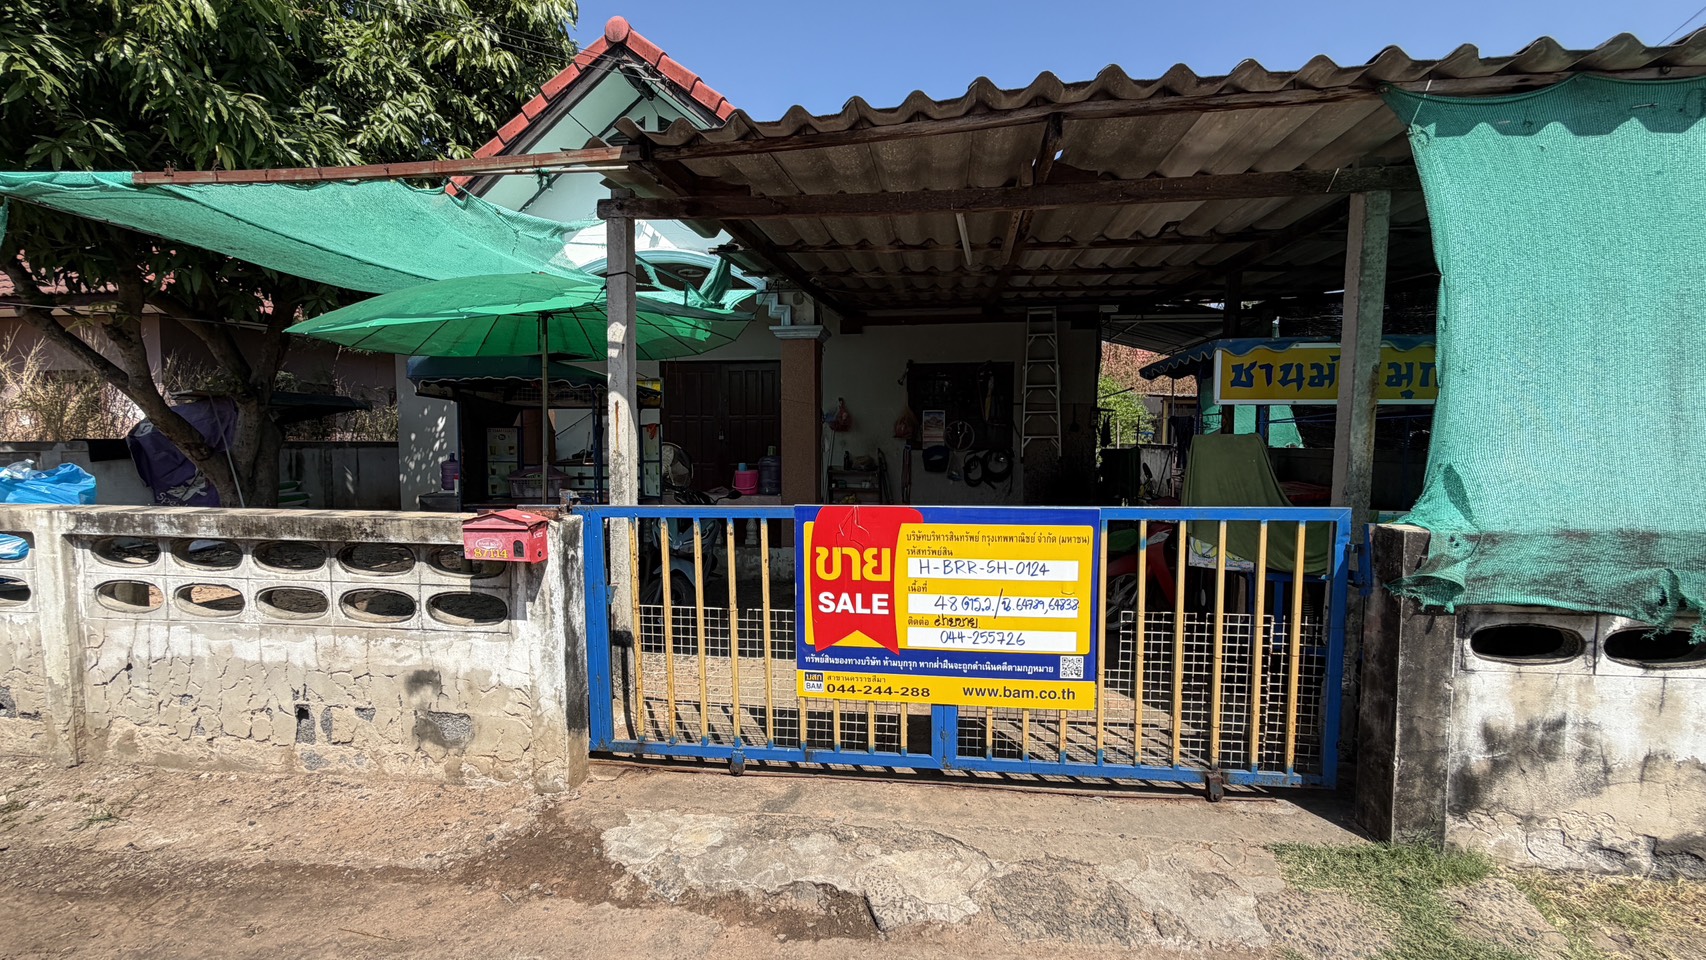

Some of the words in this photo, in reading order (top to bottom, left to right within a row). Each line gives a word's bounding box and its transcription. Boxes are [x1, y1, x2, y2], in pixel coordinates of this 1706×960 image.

[906, 531, 980, 543] บริษัทบริหารสินทรัพย์
[982, 532, 1036, 546] กรุงเทพพาณิชย์
[1038, 534, 1057, 544] จำกัด
[1058, 536, 1090, 545] (มหาชน)
[906, 545, 953, 556] รหัสทรัพย์สิน
[815, 546, 891, 582] ขาย
[919, 558, 1050, 577] H-BRR-SH-0124
[907, 580, 928, 593] เนื้อที่
[817, 591, 890, 615] SALE
[908, 616, 930, 626] ติดต่อ
[940, 630, 1026, 646] 044-255726
[804, 653, 882, 667] ทรัพย์สินของทางบริษัท
[882, 656, 918, 671] ห้ามบุกรุก
[806, 682, 823, 690] BAM
[826, 674, 887, 683] สาขานครราชสีมา
[826, 683, 931, 698] 044-244-288
[962, 685, 1076, 700] www.bam.co.th
